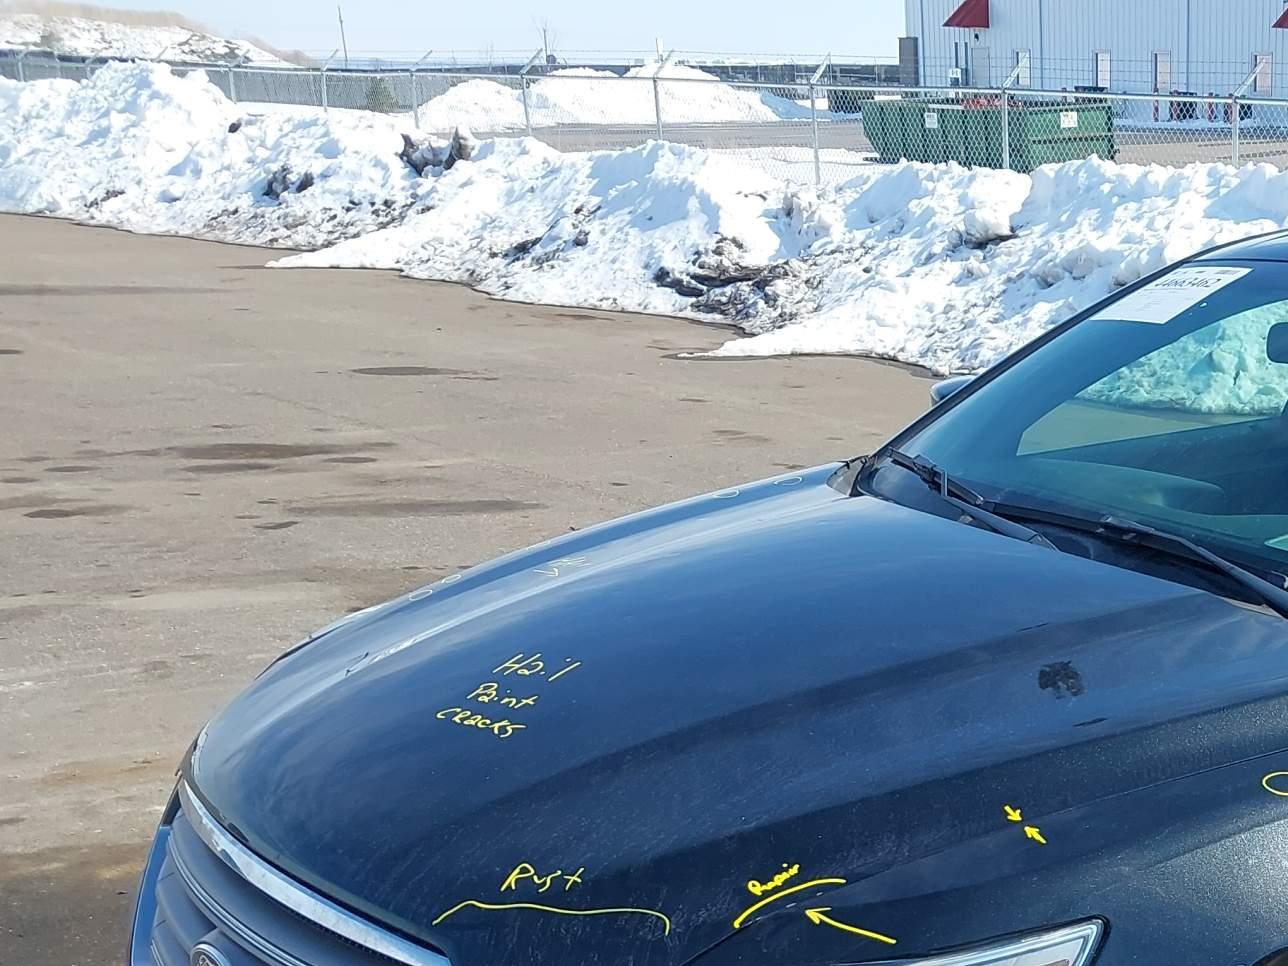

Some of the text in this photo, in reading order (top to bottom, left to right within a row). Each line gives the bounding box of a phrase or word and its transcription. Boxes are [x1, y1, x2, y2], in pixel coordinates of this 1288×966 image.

[492, 653, 582, 682] Hail
[466, 682, 539, 709] Paint
[500, 863, 585, 892] Rust
